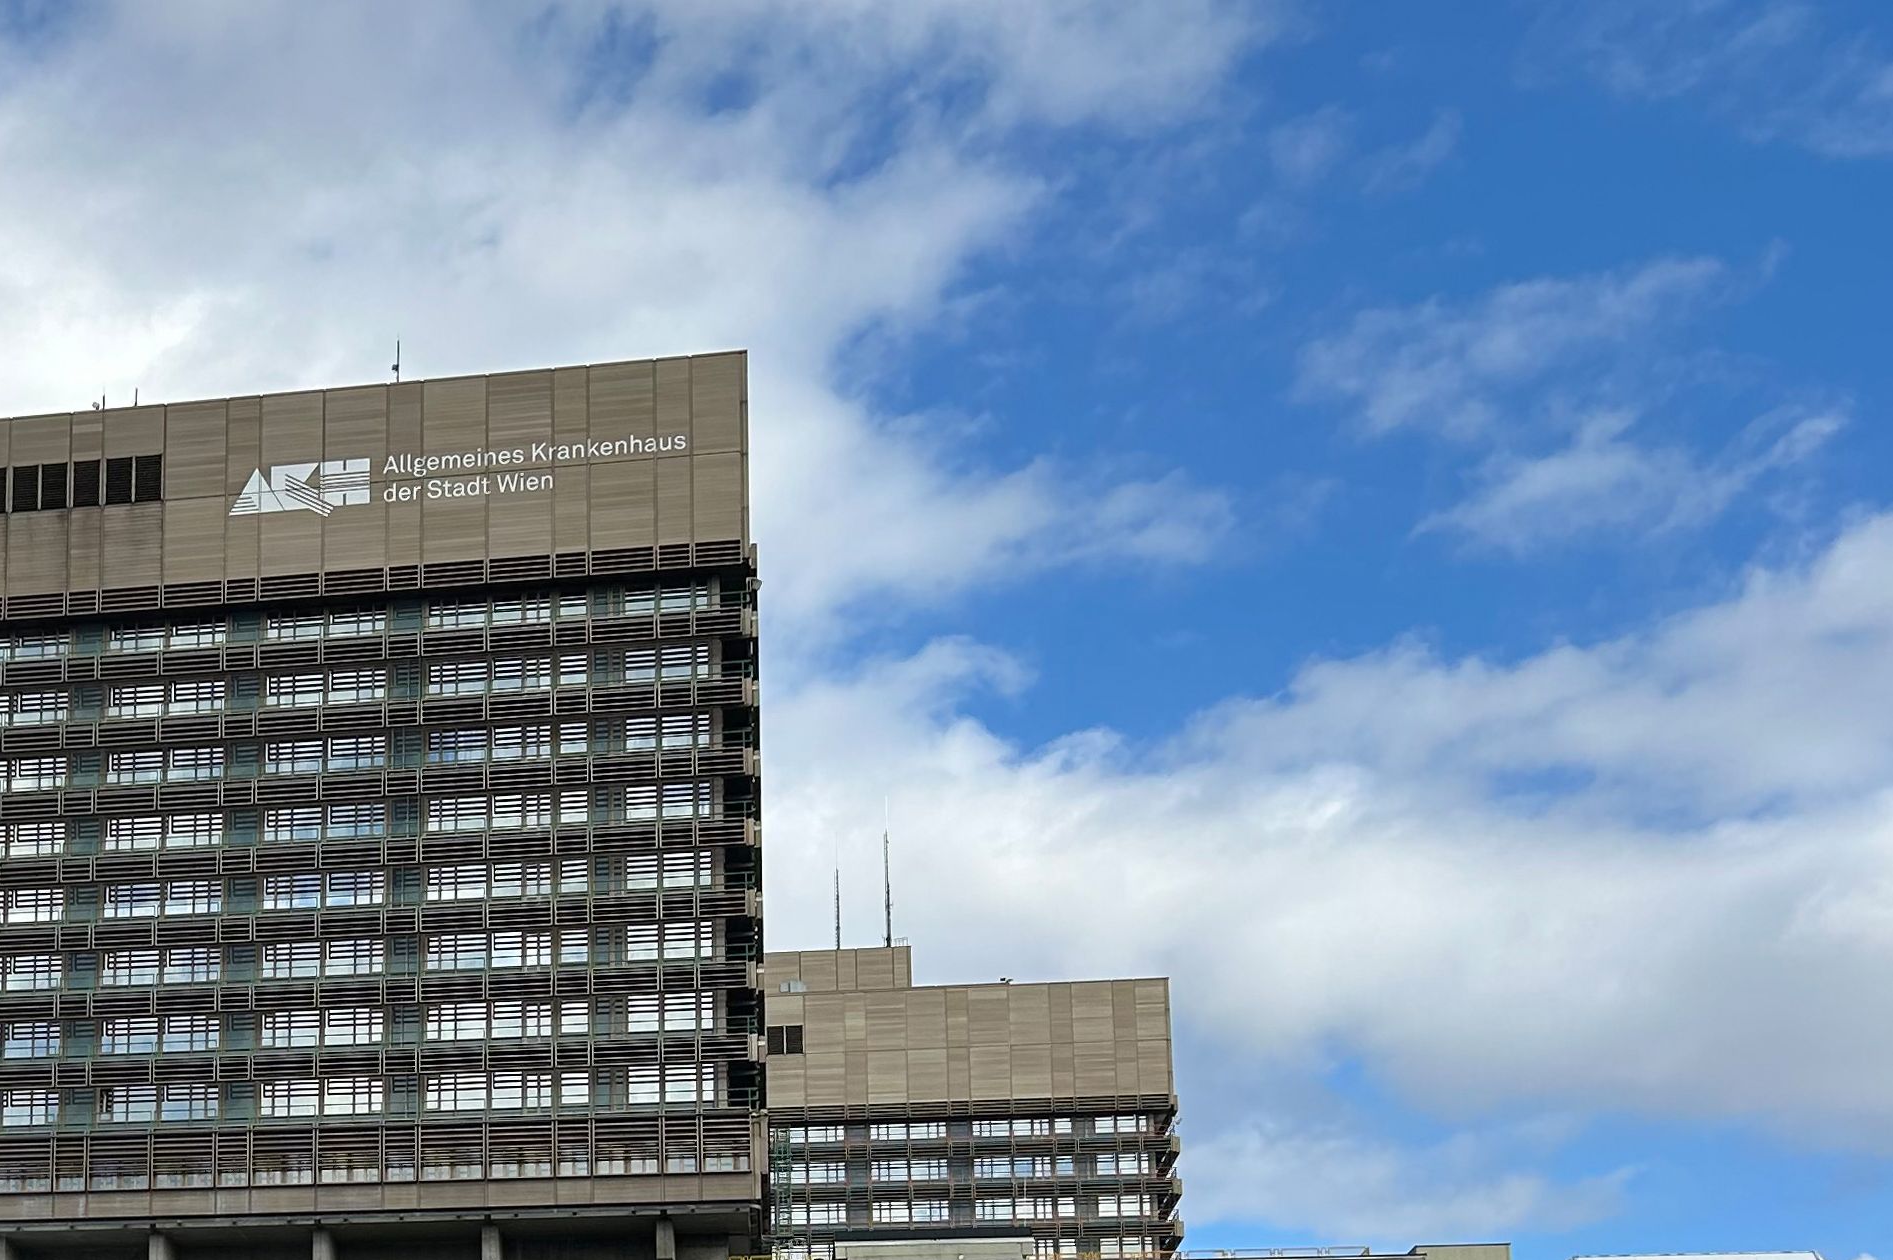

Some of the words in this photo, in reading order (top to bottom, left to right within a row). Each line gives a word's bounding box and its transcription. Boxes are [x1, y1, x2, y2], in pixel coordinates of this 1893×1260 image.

[383, 447, 525, 477] Allgemeines
[531, 434, 687, 462] Krankenhaus
[383, 482, 422, 503] der
[426, 475, 492, 499] Stadt
[496, 472, 554, 493] Wien
